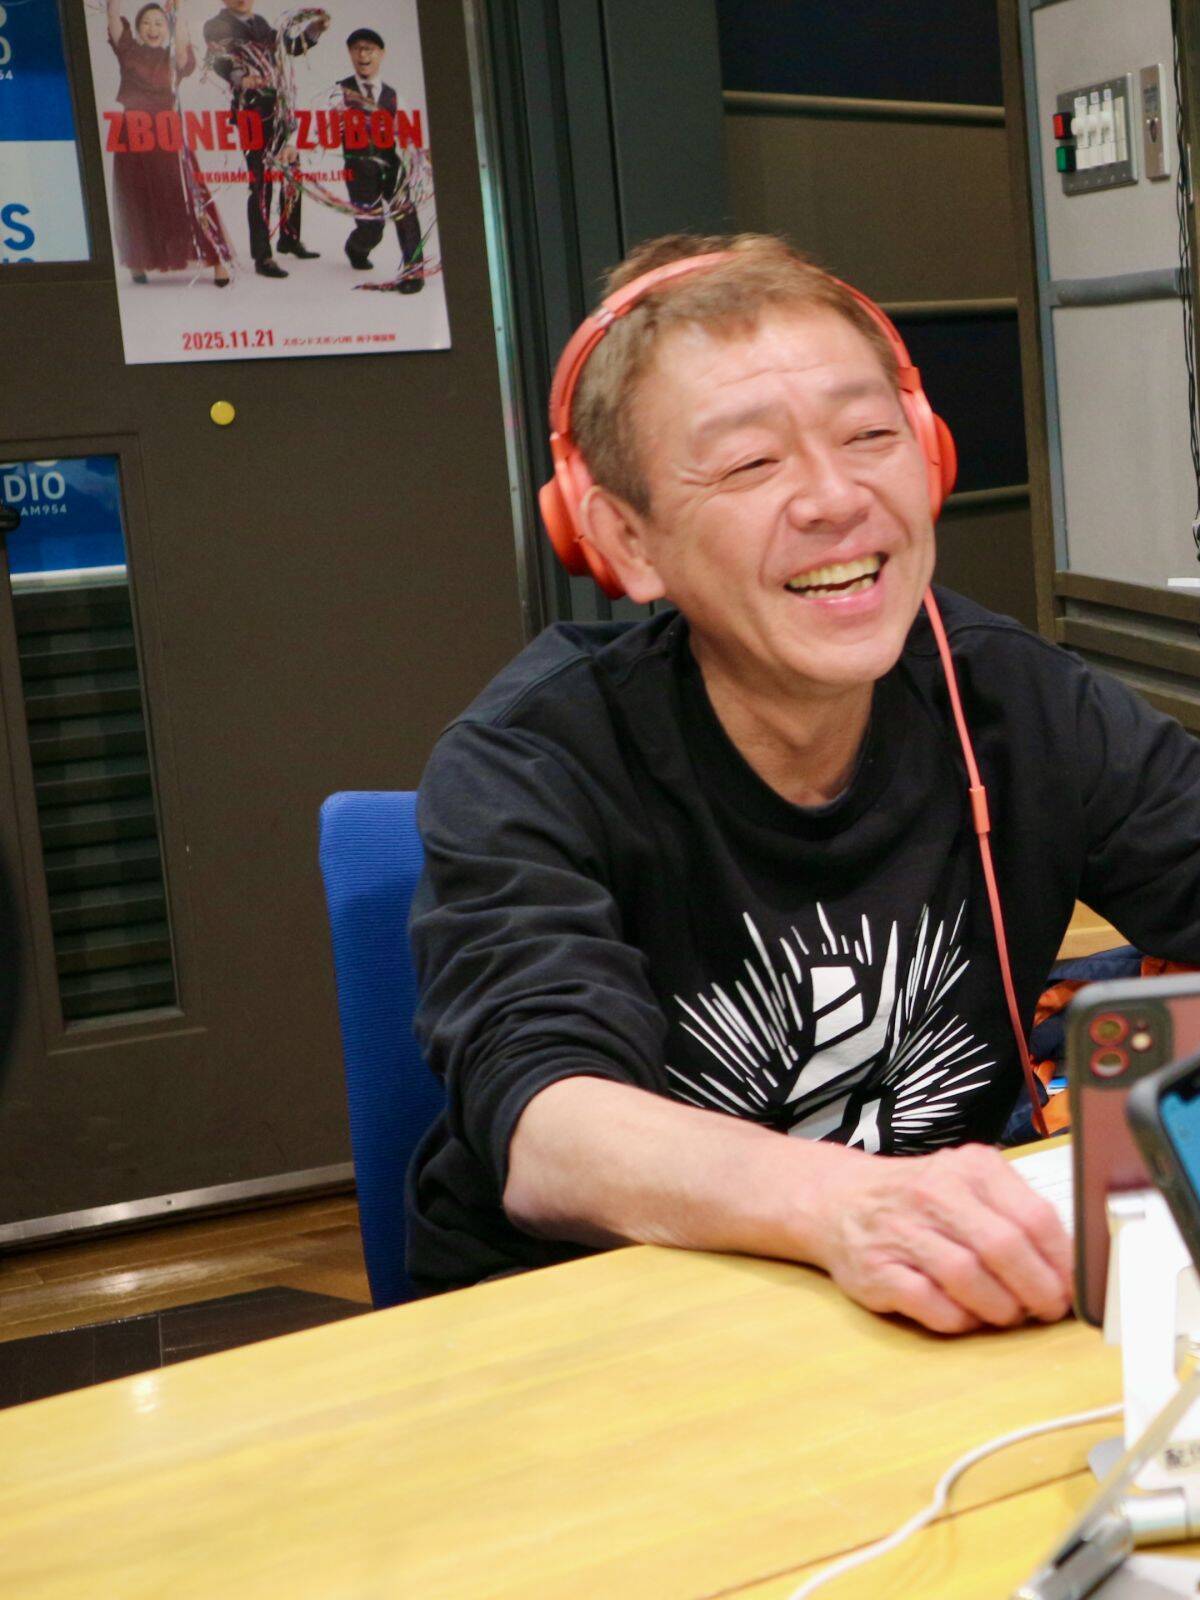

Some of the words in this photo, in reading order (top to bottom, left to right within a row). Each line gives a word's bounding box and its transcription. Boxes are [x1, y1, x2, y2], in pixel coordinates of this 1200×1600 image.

[103, 109, 265, 153] ZBONED
[296, 109, 424, 150] ZUBON
[182, 329, 275, 351] 2025.11.21
[3, 472, 66, 502] DIO
[20, 503, 68, 517] AM954
